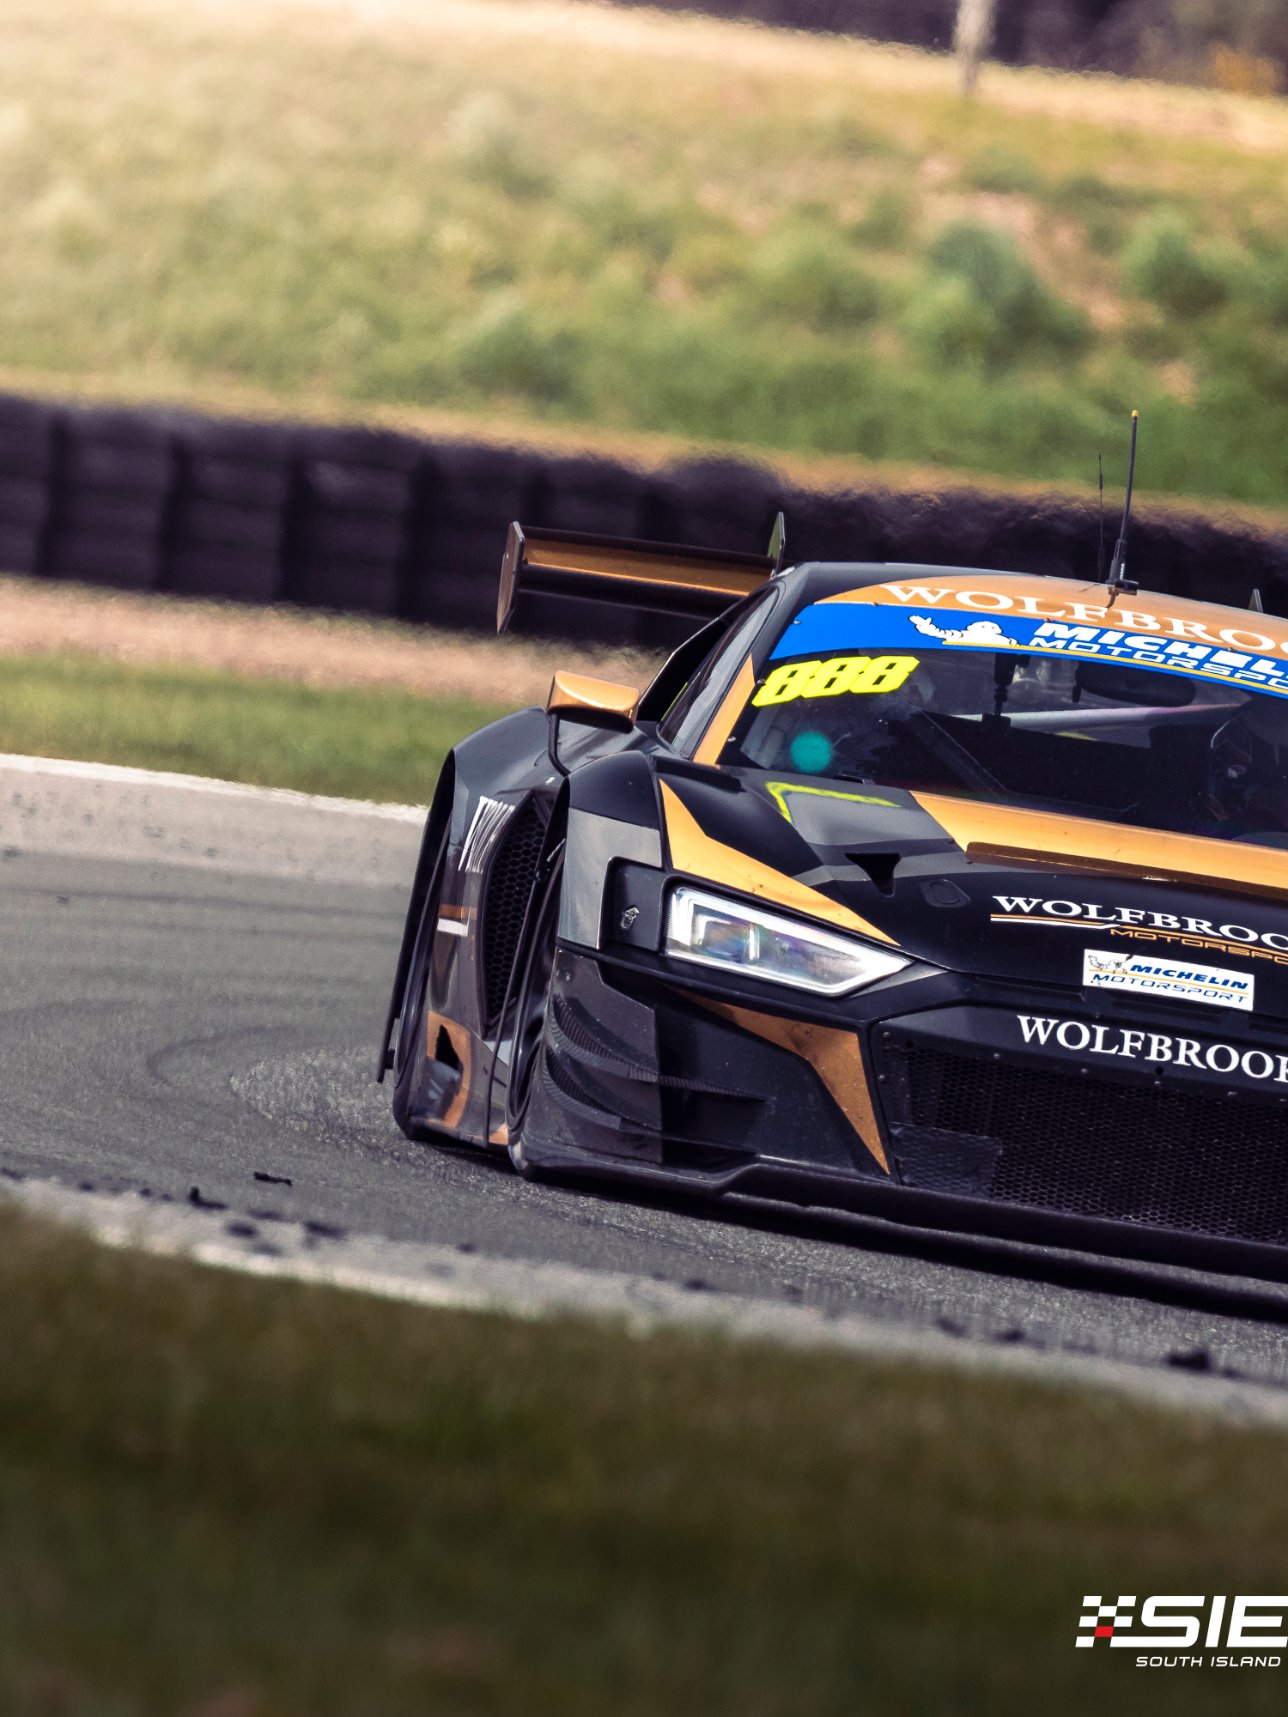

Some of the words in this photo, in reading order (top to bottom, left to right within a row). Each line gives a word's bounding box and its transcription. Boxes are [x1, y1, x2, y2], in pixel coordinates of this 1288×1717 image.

[751, 655, 921, 707] 888
[1092, 973, 1249, 1003] MOTORSPORT
[1130, 964, 1249, 990] MICHELIN
